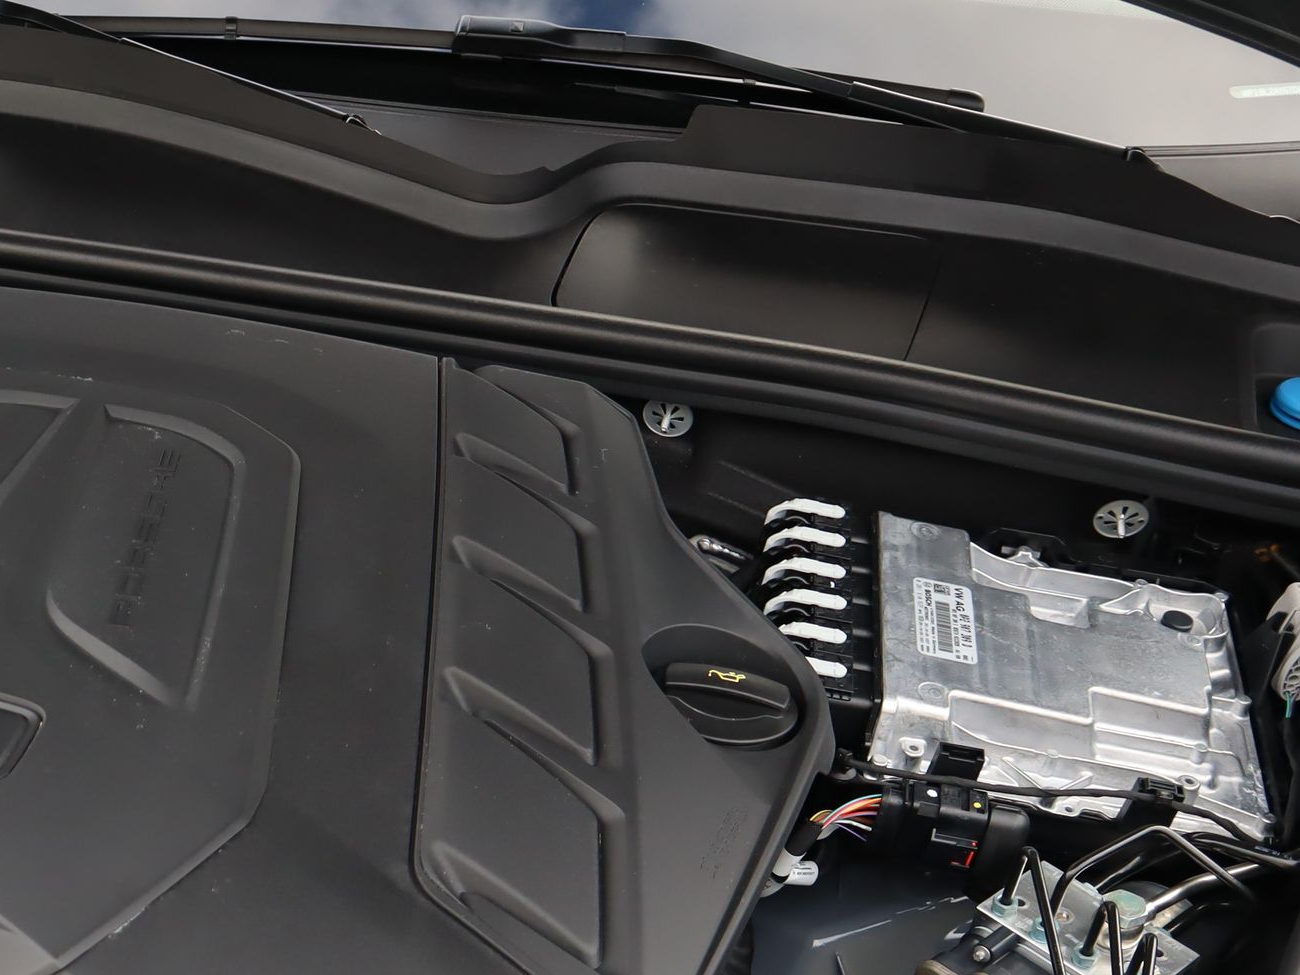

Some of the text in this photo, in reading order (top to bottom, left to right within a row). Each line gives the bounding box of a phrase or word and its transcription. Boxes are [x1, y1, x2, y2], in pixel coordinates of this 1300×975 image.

[924, 588, 932, 607] BOSCH
[954, 587, 964, 600] VW
[955, 600, 965, 612] AG
